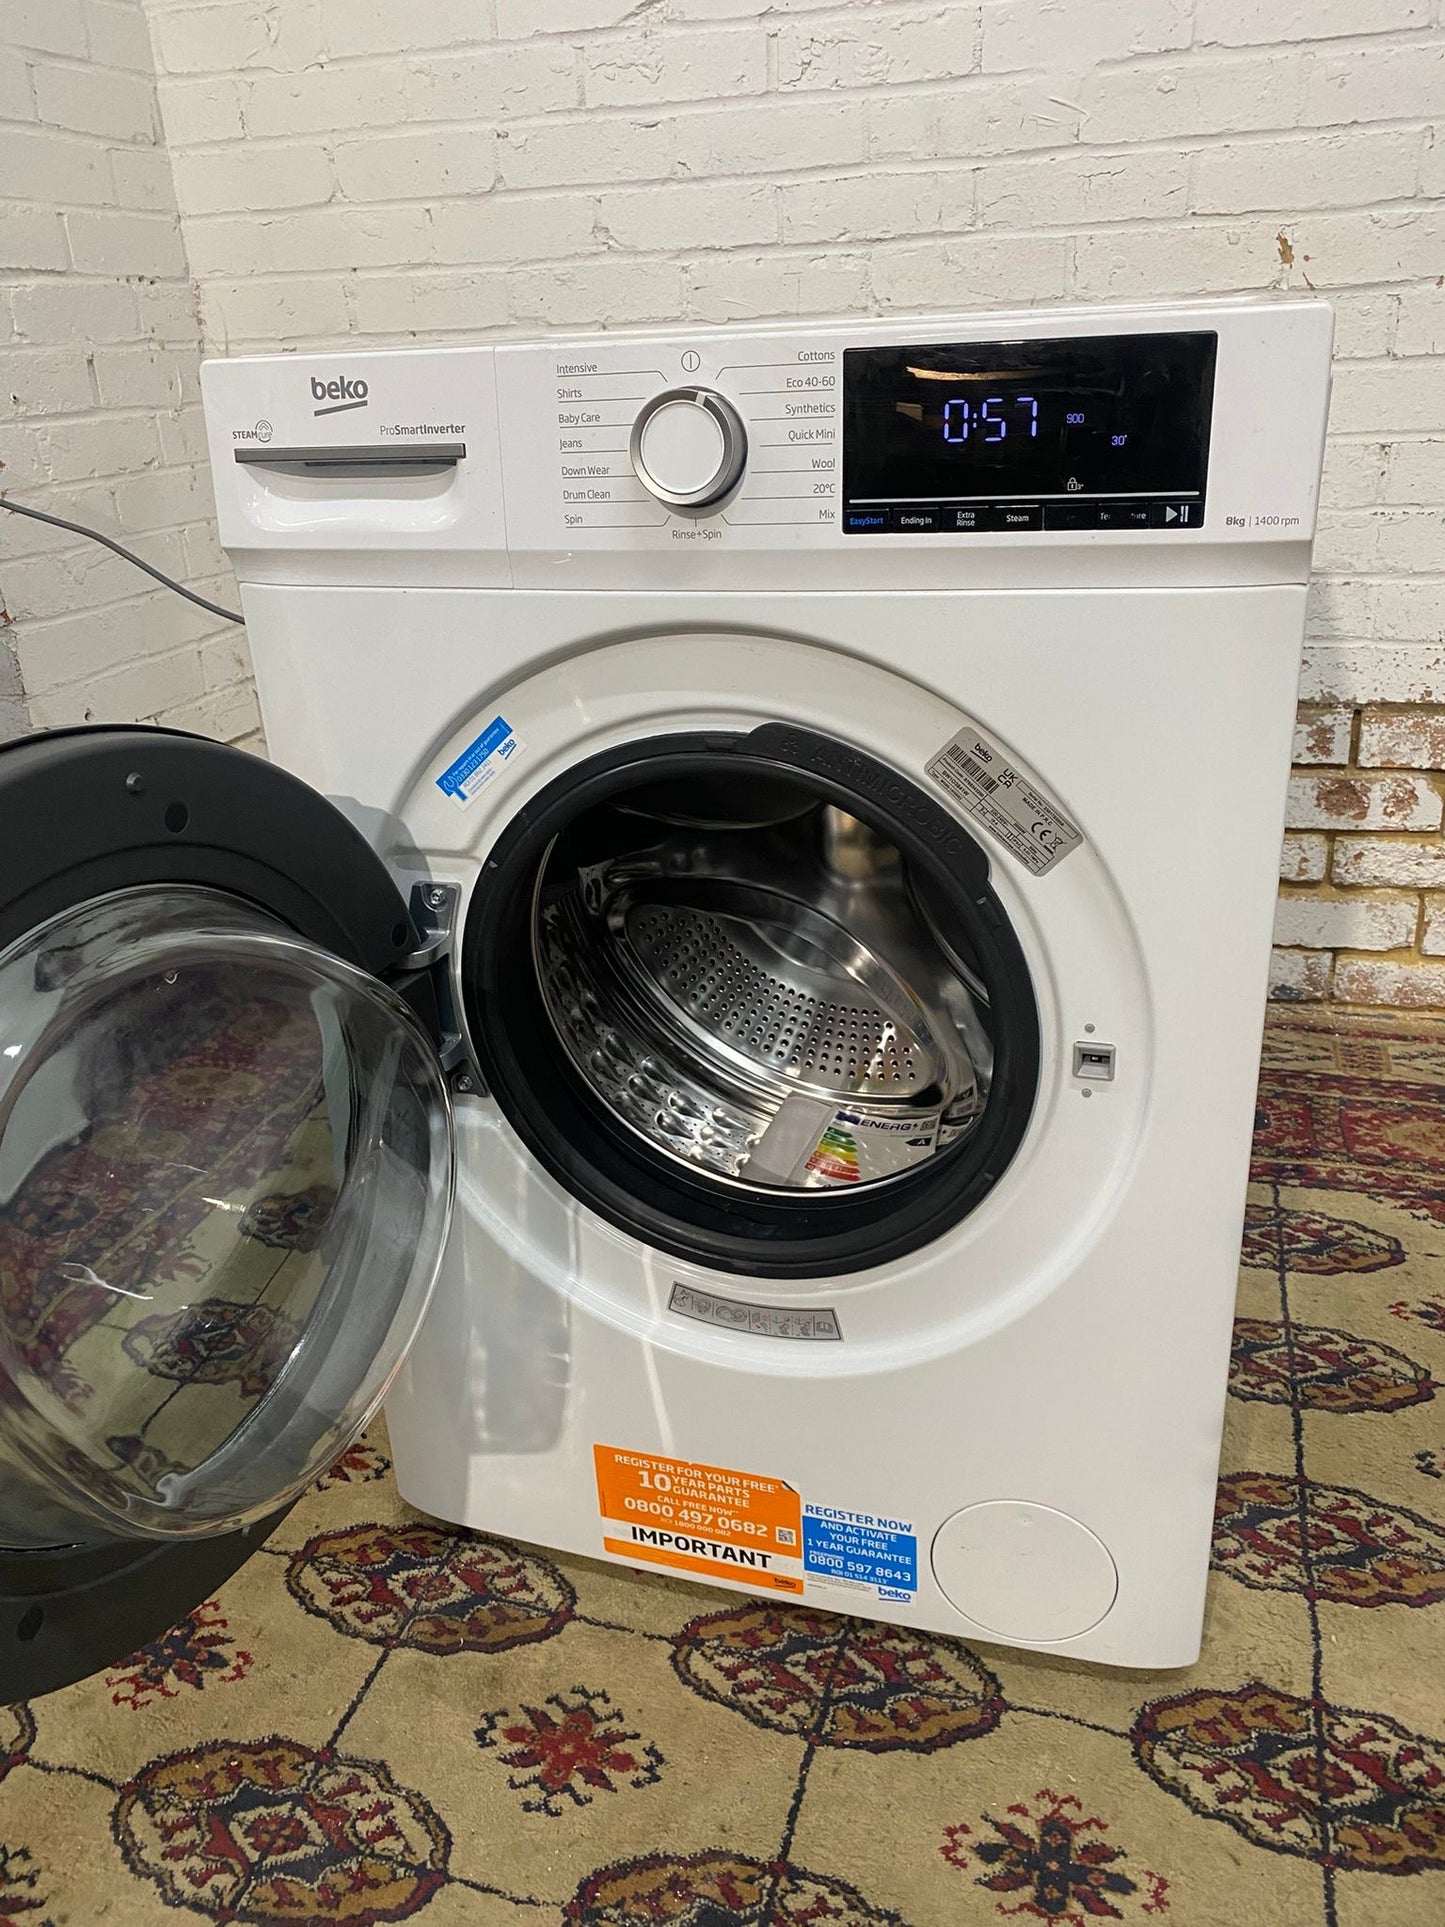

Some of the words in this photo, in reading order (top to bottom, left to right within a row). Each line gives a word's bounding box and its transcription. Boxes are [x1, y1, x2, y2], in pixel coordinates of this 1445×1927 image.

[797, 351, 836, 362] Cottons
[556, 362, 598, 374] Intensive
[310, 375, 368, 400] beko
[786, 378, 803, 388] Eco
[804, 376, 836, 387] 40-60
[556, 388, 583, 399] Shirts
[784, 403, 836, 416] Synthetics
[558, 413, 580, 425] Baby
[581, 413, 601, 423] Care
[943, 396, 1038, 443] 0:57
[1066, 413, 1085, 424] 900
[379, 424, 466, 436] ProSmartInverter
[788, 429, 814, 441] Quick
[815, 429, 836, 440] Mini
[559, 438, 583, 449] Jeans
[811, 458, 836, 469] Wool
[561, 466, 584, 476] Down
[586, 465, 610, 475] Wear
[563, 490, 586, 500] Drum
[587, 489, 611, 499] Clean
[564, 514, 583, 525] Spin
[818, 509, 836, 519] Mix
[957, 511, 976, 519] Extra
[1006, 514, 1029, 523] Steam
[850, 517, 884, 525] EasyStart
[901, 517, 923, 526] Ending
[924, 517, 933, 525] In
[956, 518, 976, 527] Rinse
[1225, 515, 1246, 528] 8kg
[1254, 516, 1280, 526] 1400
[1281, 517, 1300, 528] rpm
[497, 737, 515, 755] beko
[973, 742, 994, 762] beko
[1002, 768, 1018, 782] UK
[860, 1119, 911, 1131] ENERG
[614, 1454, 675, 1474] REGISTER
[677, 1466, 702, 1479] FOR
[704, 1472, 741, 1488] YOUR
[637, 1470, 672, 1492] 10
[671, 1475, 706, 1491] YEAR
[708, 1482, 751, 1499] PARTS
[657, 1495, 681, 1507] CALL
[683, 1500, 708, 1512] FREE
[673, 1486, 751, 1509] GUARANTEE
[624, 1497, 674, 1518] 0800
[678, 1508, 714, 1526] 497
[717, 1516, 769, 1538] 0682
[805, 1504, 874, 1526] REGISTER
[877, 1518, 913, 1533] NOW
[820, 1520, 844, 1532] AND
[845, 1525, 898, 1543] ACTIVATE
[631, 1526, 772, 1569] IMPORTANT
[829, 1532, 860, 1546] YOUR
[861, 1538, 888, 1551] FREE
[807, 1538, 814, 1547] 1
[815, 1540, 845, 1552] YEAR
[845, 1545, 912, 1565] GUARANTEE
[808, 1554, 844, 1569] 0800
[847, 1561, 873, 1574] 597
[875, 1567, 912, 1582] 8643
[774, 1577, 797, 1588] beko
[878, 1586, 912, 1600] beko
